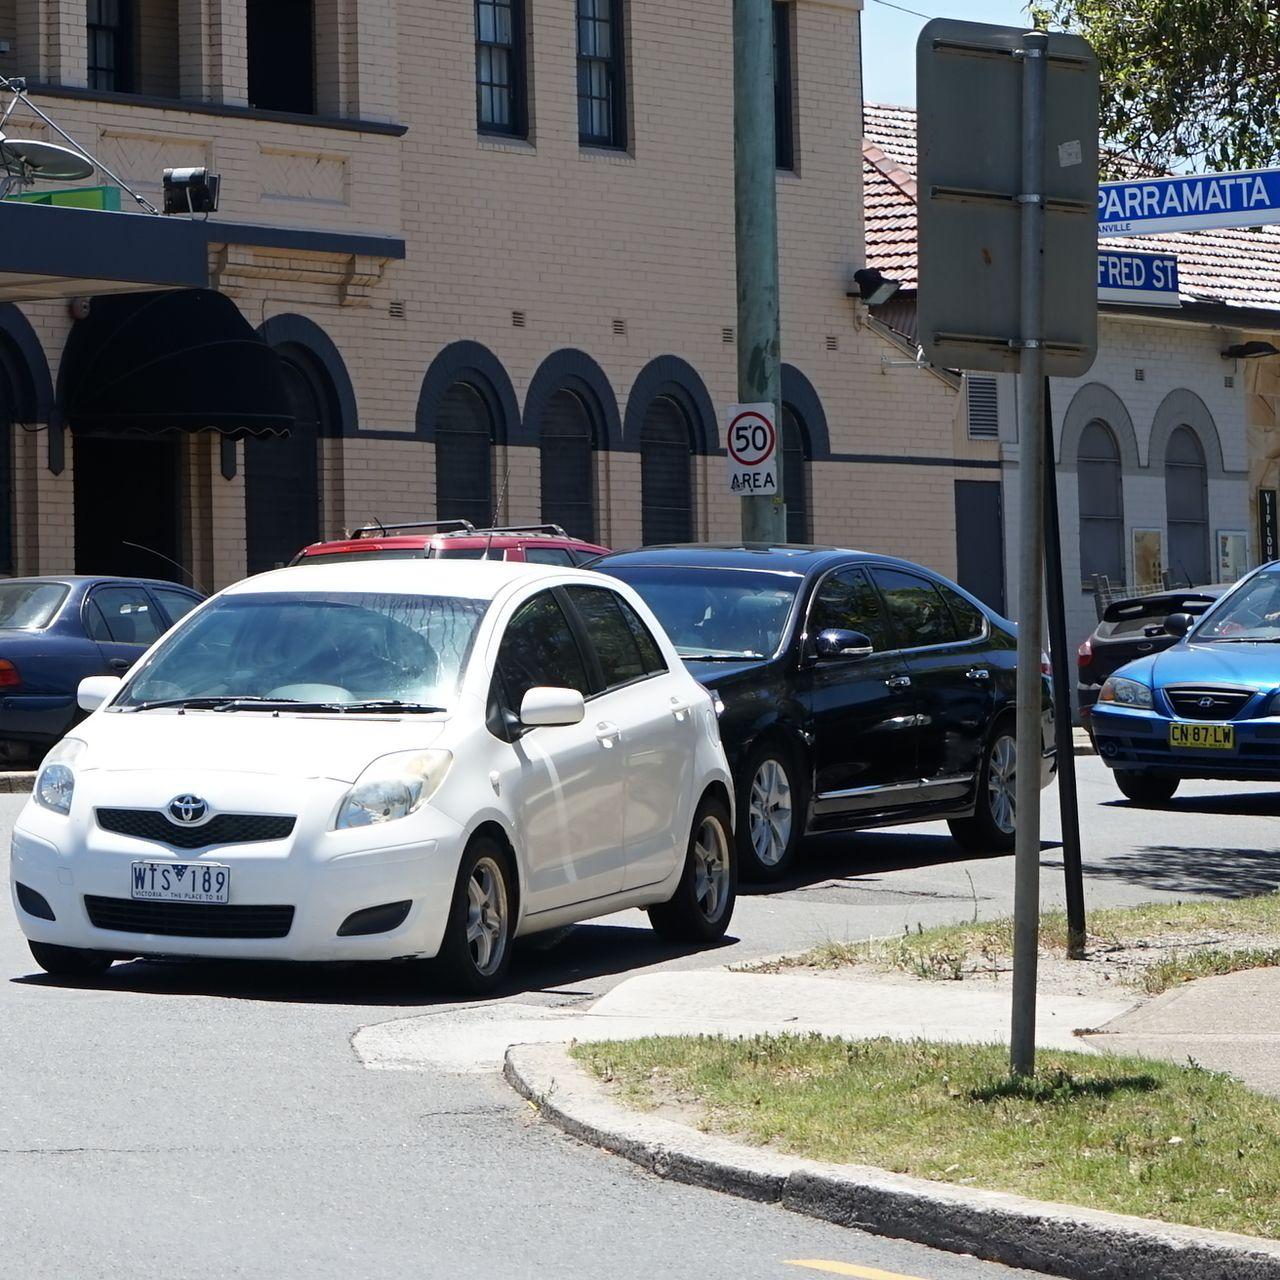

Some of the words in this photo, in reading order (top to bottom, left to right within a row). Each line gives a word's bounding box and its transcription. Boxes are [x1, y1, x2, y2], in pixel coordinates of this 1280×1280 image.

[1152, 259, 1175, 289] ST
[735, 425, 768, 453] 50
[730, 472, 775, 490] AREA
[133, 867, 171, 891] WTS
[191, 870, 226, 893] 189
[135, 890, 162, 898] VICTORIA
